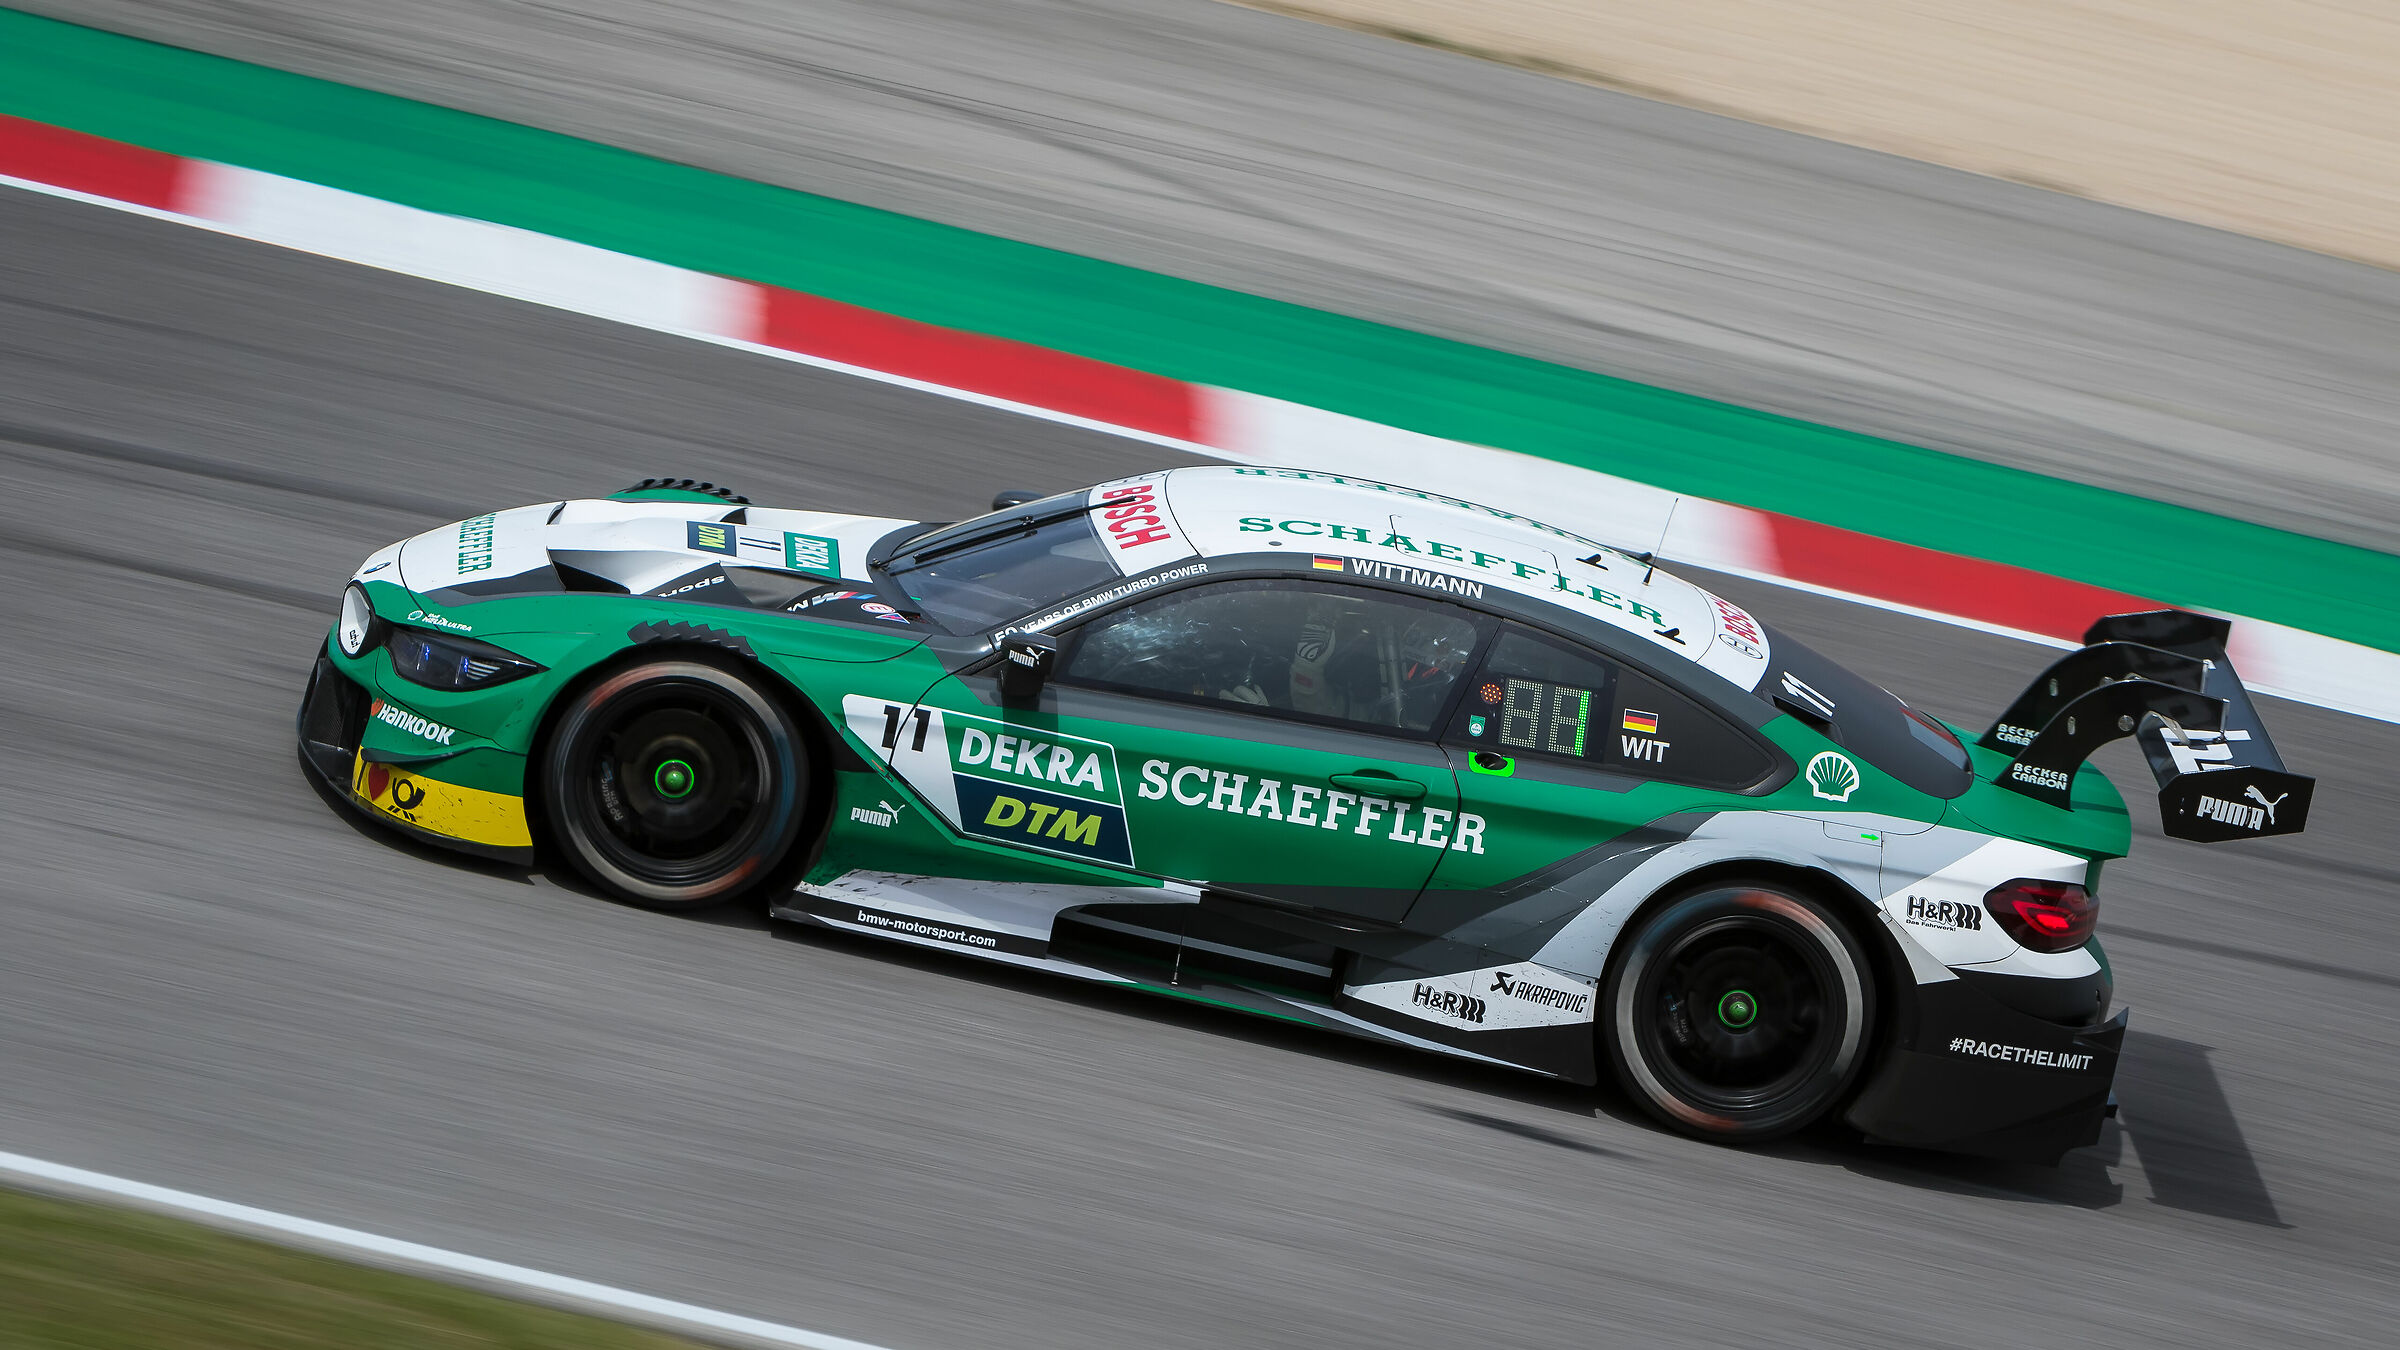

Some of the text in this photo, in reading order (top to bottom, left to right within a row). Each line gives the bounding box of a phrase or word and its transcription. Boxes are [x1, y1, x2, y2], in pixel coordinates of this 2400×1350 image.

[1102, 484, 1172, 550] BOSCH
[458, 512, 497, 575] CHAEFFLER
[698, 525, 726, 549] DTM
[740, 537, 782, 552] 11
[794, 536, 830, 570] DEKRA
[1238, 517, 1668, 628] SCHAEFFLER
[1351, 557, 1485, 600] WITTMANN
[1020, 610, 1062, 634] YEARS
[1063, 602, 1082, 617] OF
[1082, 590, 1115, 612] BMW
[1114, 575, 1159, 597] TURBO
[1160, 563, 1209, 582] POWER
[1008, 649, 1035, 668] PUMA
[1782, 671, 1836, 717] 11
[881, 704, 932, 753] 11
[1996, 732, 2032, 747] CARB
[1998, 723, 2040, 740] BECK
[958, 727, 1105, 792] DEKRA
[1620, 735, 1670, 763] WIT
[2011, 771, 2067, 791] CARBON
[2013, 762, 2069, 783] BECKER
[850, 806, 893, 828] PUMA
[983, 795, 1102, 846] DTM
[1137, 759, 1487, 855] SCHAEFFLER
[2196, 794, 2265, 831] PUMA
[857, 909, 996, 947] bmw-motorsport.com
[1907, 895, 1957, 927] H&R
[1412, 982, 1460, 1018] H&R
[1949, 1037, 2094, 1071] #RACETHELIMIT
